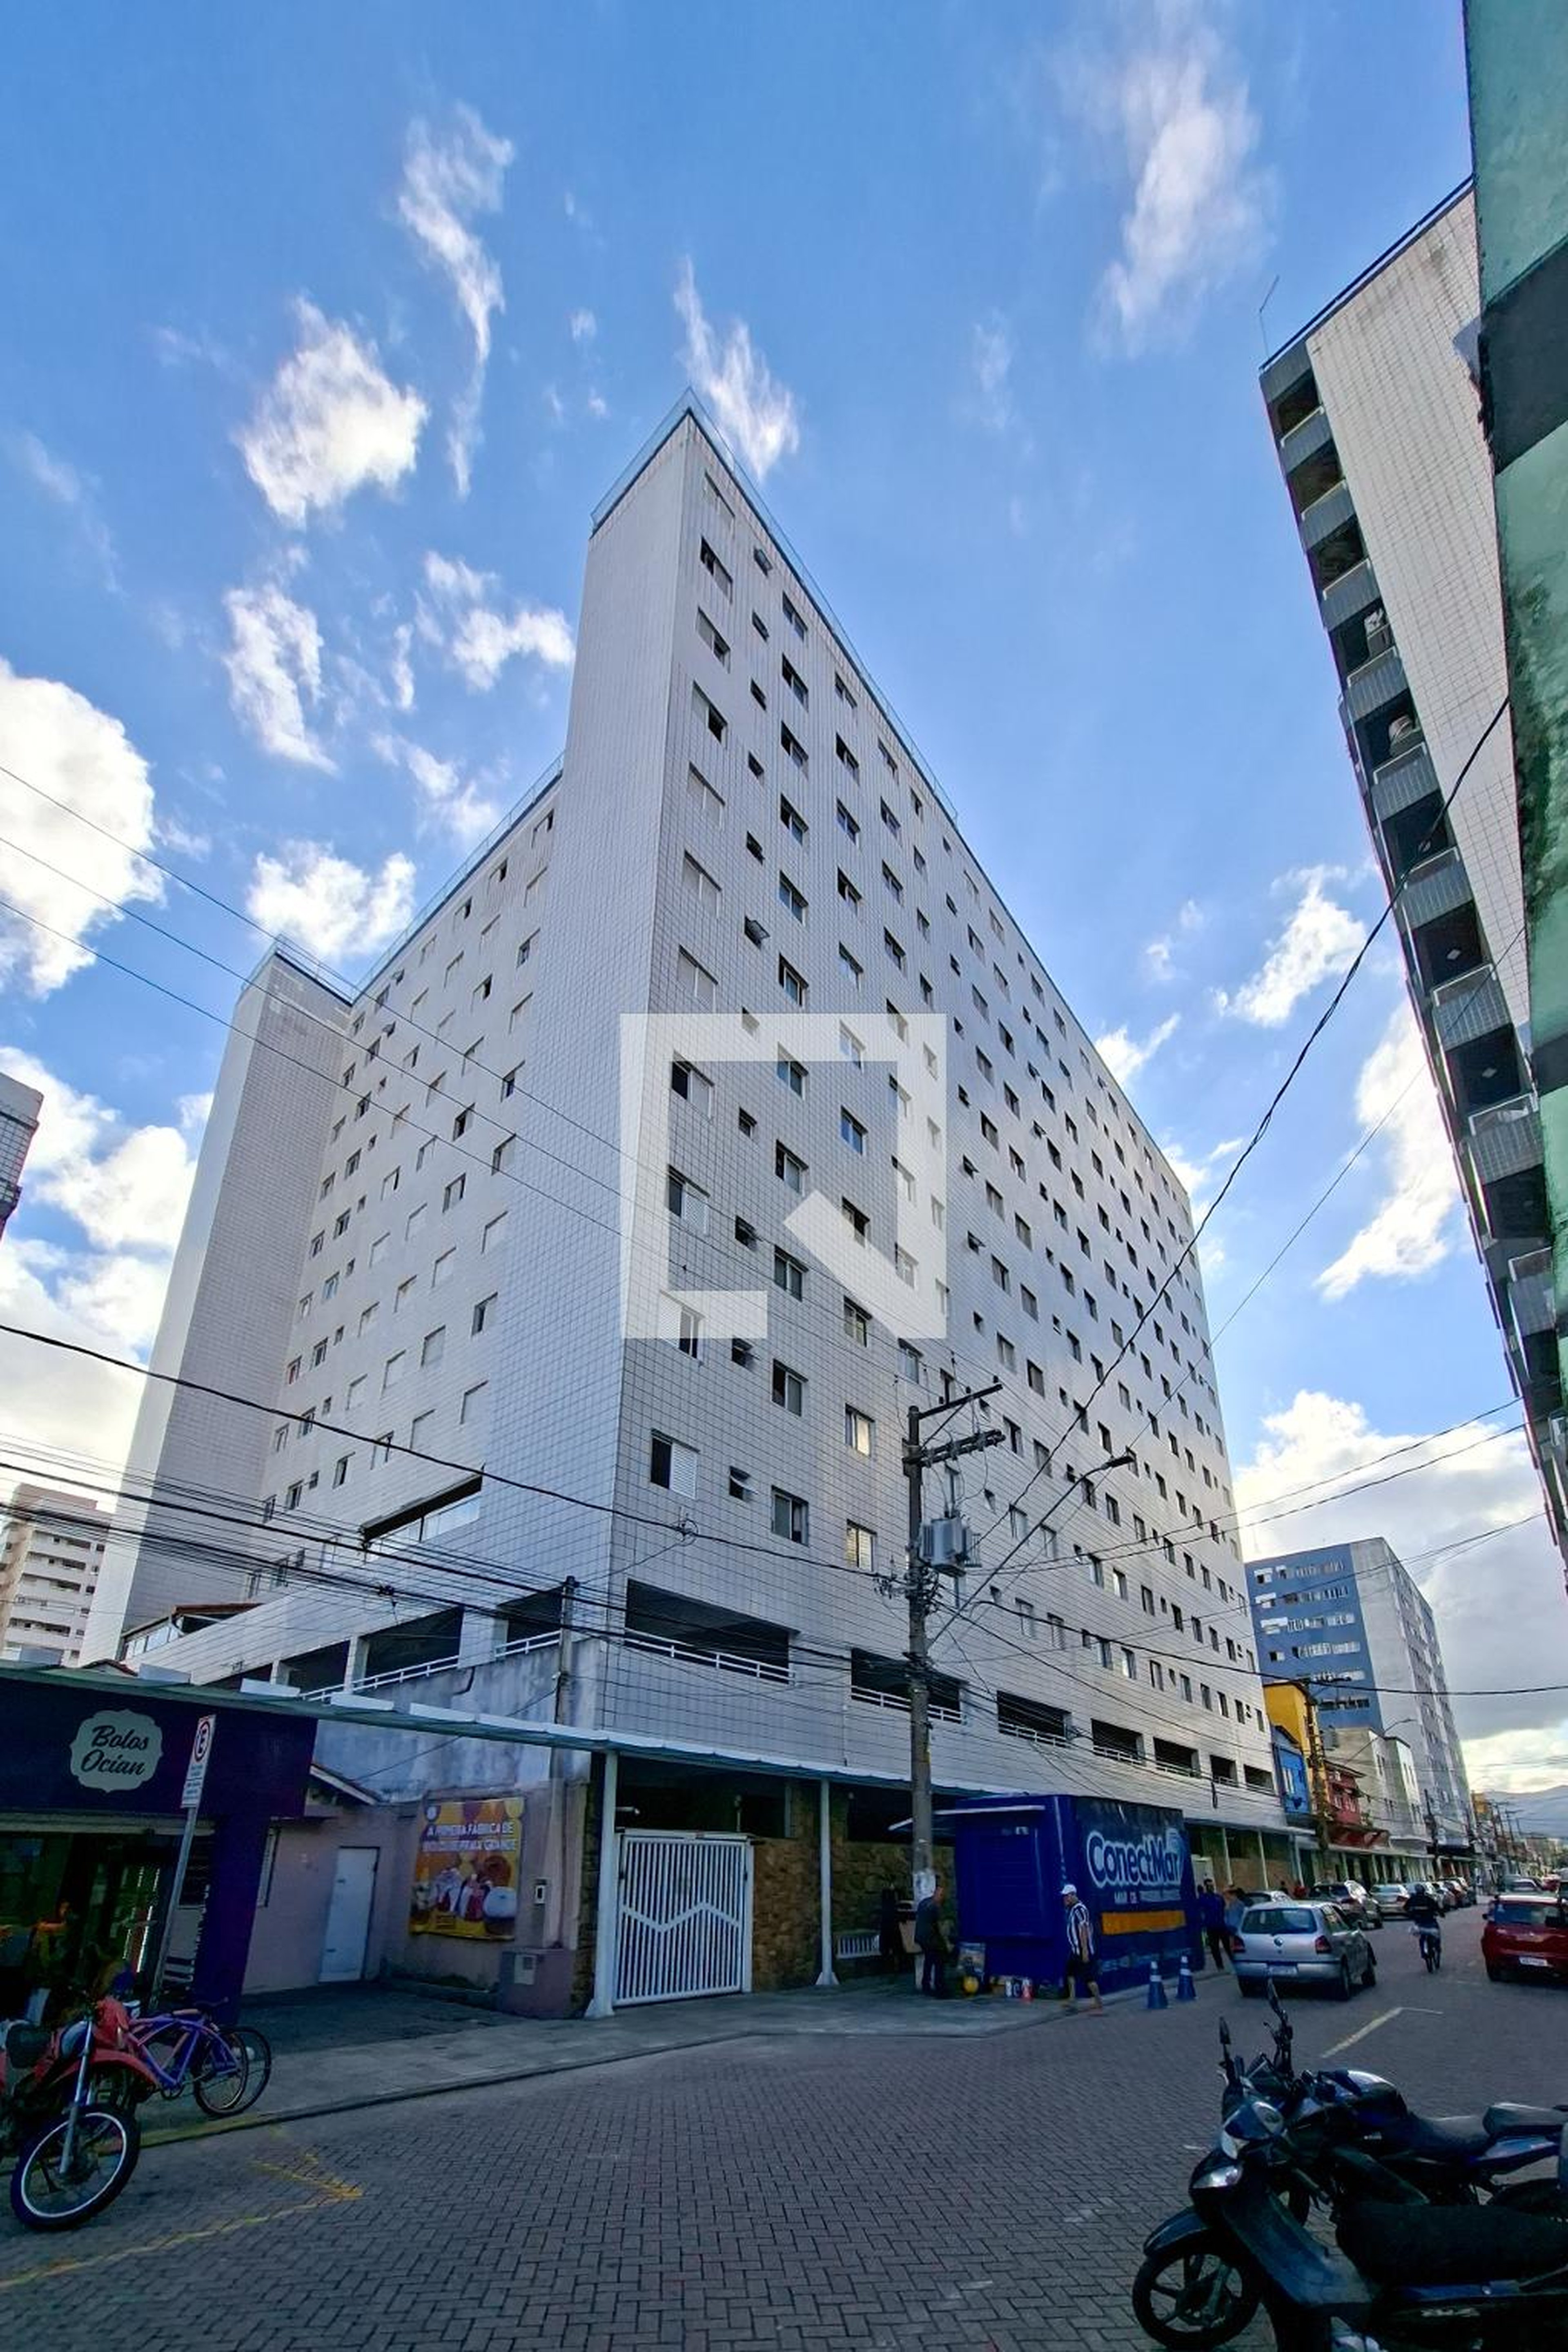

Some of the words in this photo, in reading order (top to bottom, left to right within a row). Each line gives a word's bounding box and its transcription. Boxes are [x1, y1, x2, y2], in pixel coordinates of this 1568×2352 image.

[91, 1725, 149, 1751] Bolos
[81, 1749, 145, 1775] Ocian
[1087, 1831, 1180, 1888] ConectMar
